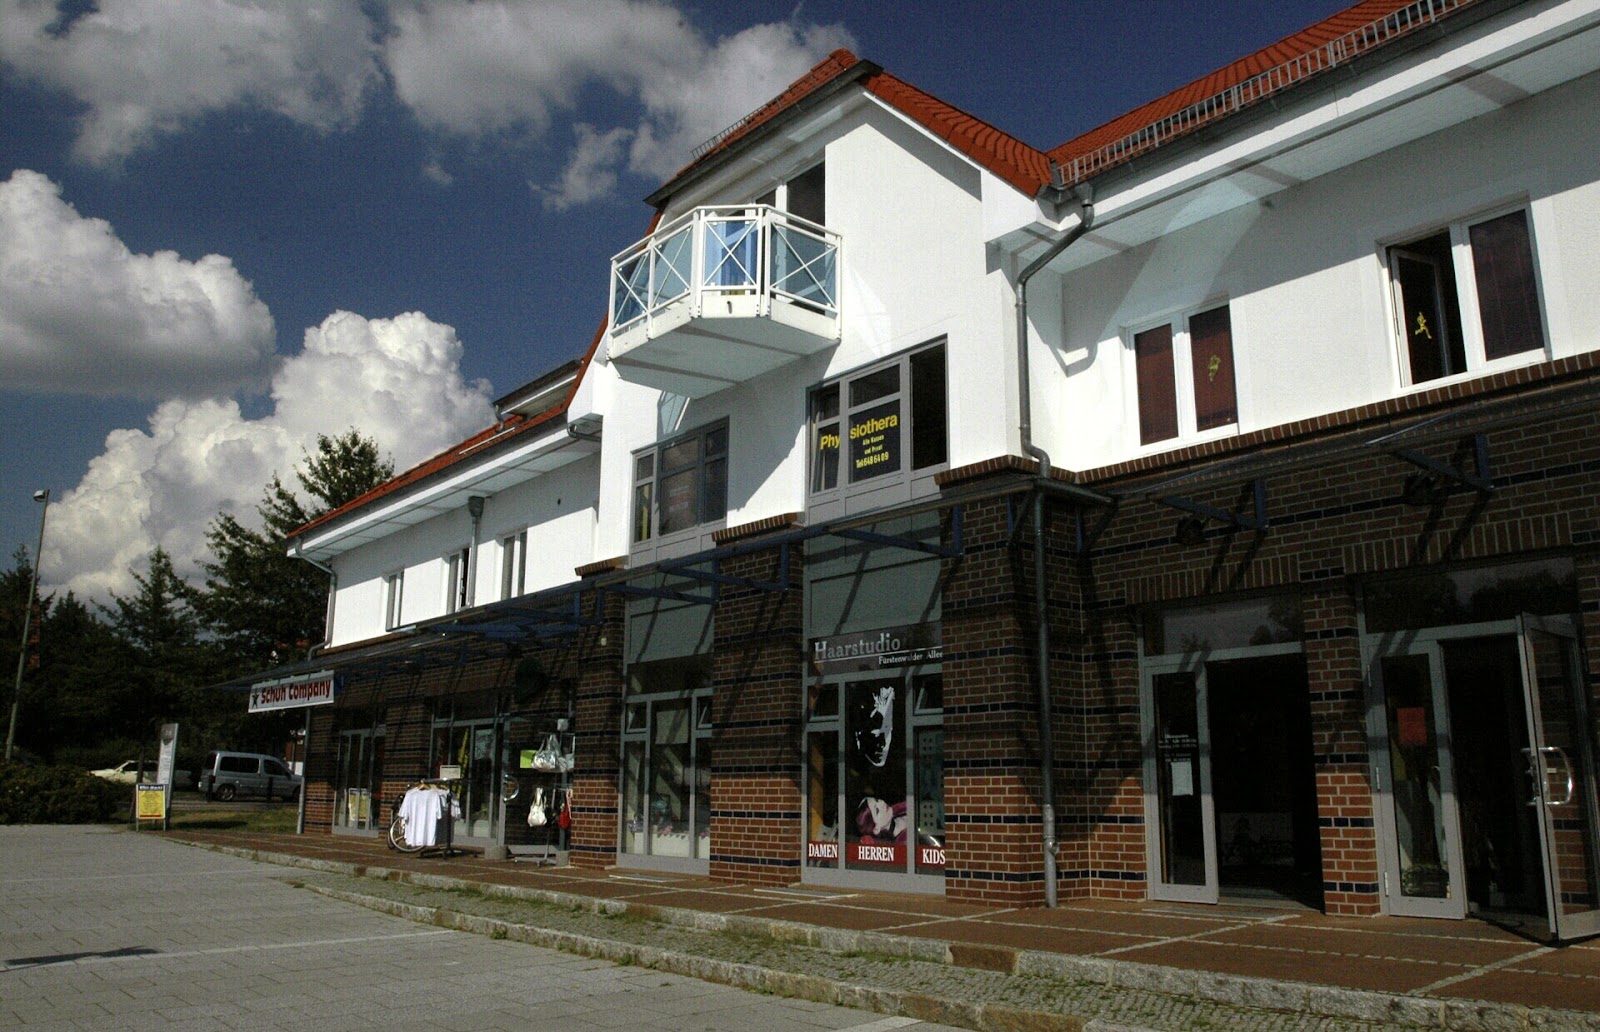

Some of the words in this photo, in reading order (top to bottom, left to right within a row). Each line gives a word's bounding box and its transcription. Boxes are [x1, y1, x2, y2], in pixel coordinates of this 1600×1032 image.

[850, 414, 898, 439] siothera
[814, 633, 901, 660] Haarstudio
[261, 685, 286, 704] Schuh
[288, 680, 331, 701] Company
[808, 843, 838, 858] DAMEN
[858, 845, 894, 861] HERREN
[922, 848, 946, 865] KIDS
